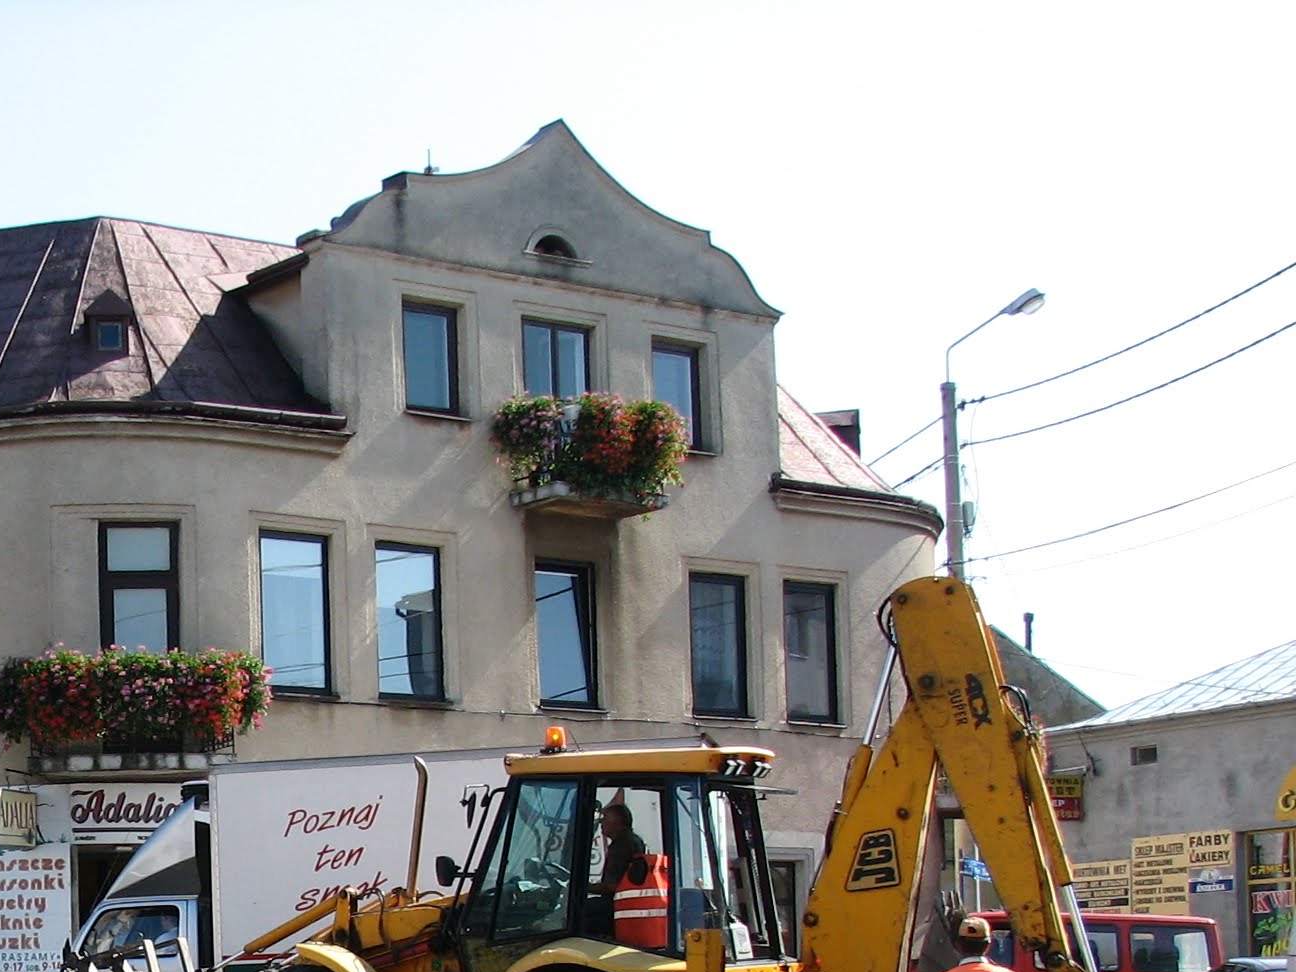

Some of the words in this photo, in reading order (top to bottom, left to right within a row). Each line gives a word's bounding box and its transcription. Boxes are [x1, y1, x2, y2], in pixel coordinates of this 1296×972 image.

[947, 688, 969, 727] SUPER
[965, 673, 993, 731] 4CX
[0, 800, 36, 831] ADALIA
[70, 789, 180, 825] Adalia
[284, 795, 384, 837] Poznaj
[1189, 833, 1231, 848] FARBY
[315, 844, 364, 872] ten
[851, 833, 896, 884] JCB
[1249, 864, 1290, 875] CAMEL
[3, 962, 23, 971] 9-17
